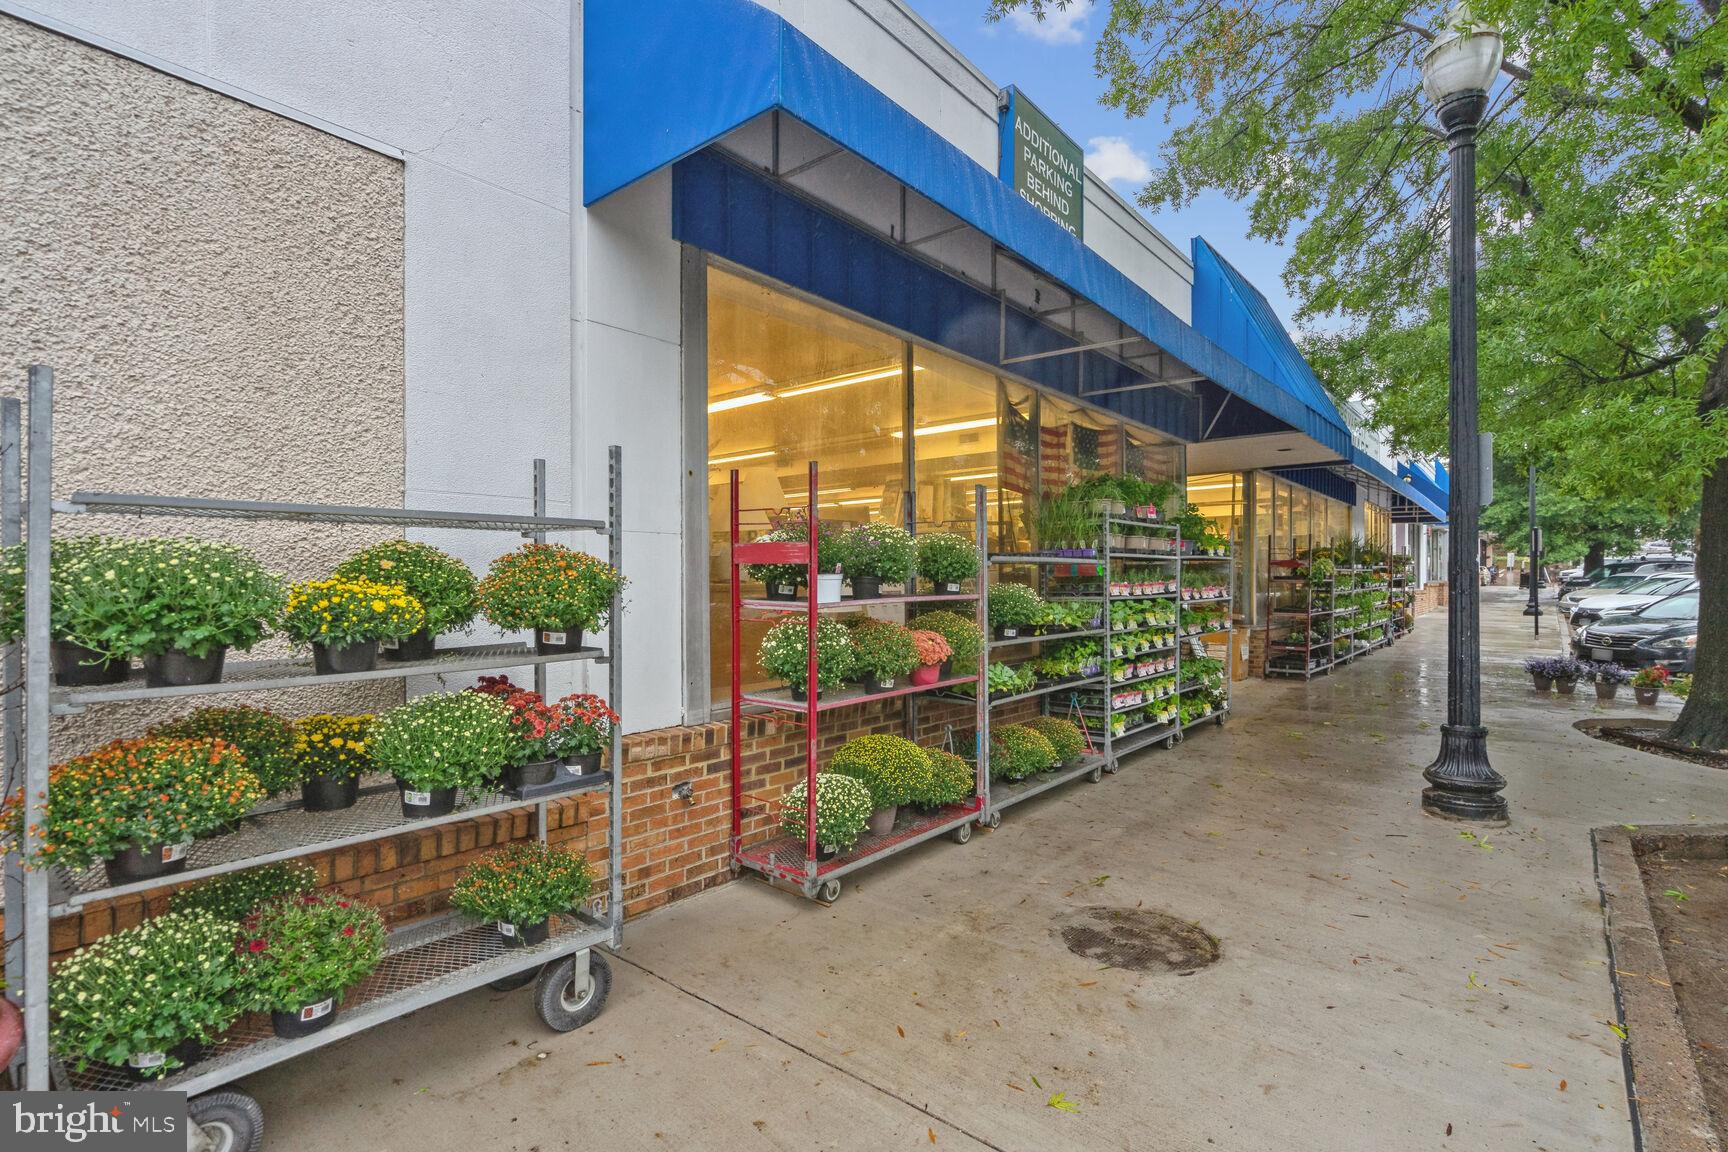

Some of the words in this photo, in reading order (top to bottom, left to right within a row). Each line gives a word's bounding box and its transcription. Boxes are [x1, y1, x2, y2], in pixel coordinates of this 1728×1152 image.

[1015, 116, 1082, 184] ADDITIONAL
[1024, 146, 1073, 198] PARKING
[1026, 171, 1070, 216] BEHIND
